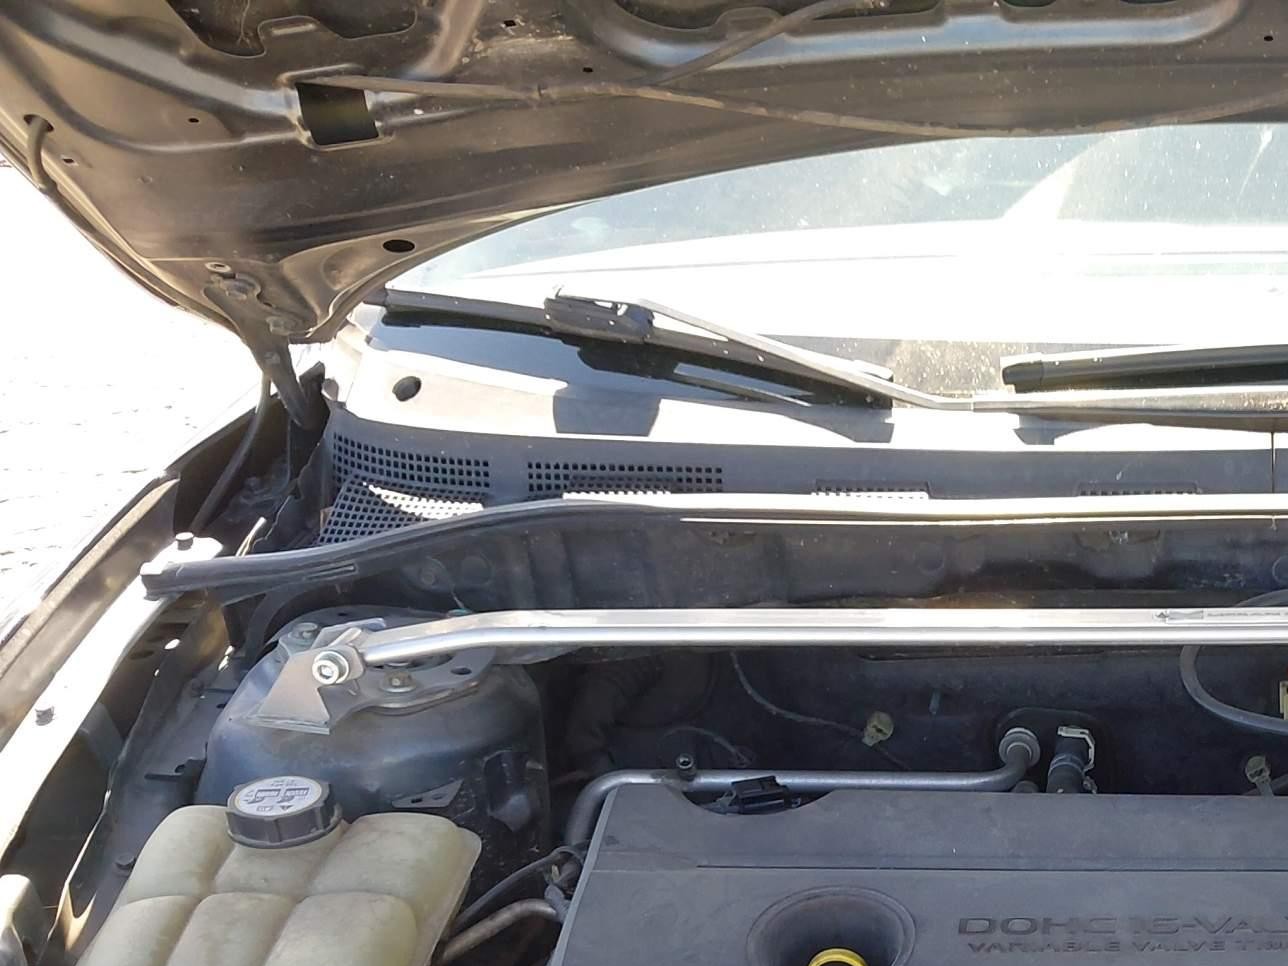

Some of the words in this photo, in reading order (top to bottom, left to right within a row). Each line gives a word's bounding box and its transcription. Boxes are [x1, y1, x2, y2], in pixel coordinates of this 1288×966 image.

[957, 917, 1117, 936] DOHC
[967, 941, 1121, 954] VARIABLE
[1132, 940, 1228, 953] VALVE
